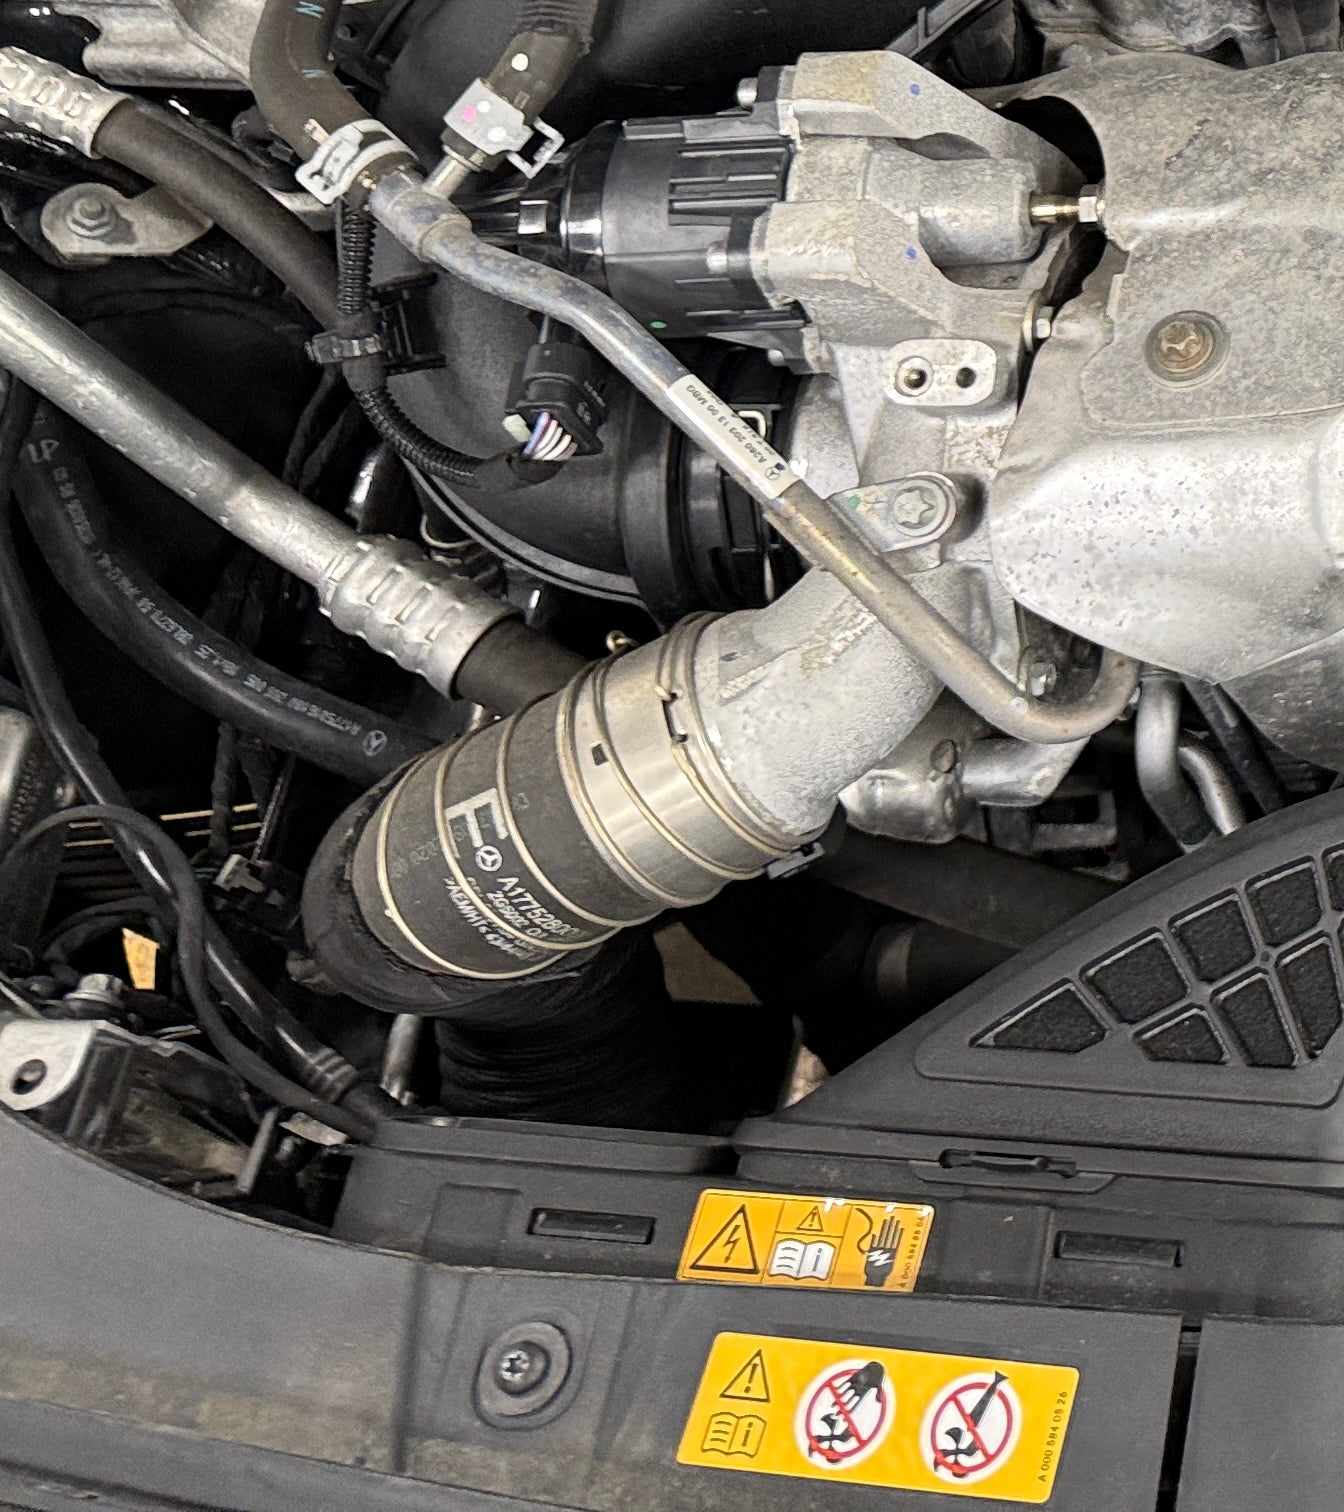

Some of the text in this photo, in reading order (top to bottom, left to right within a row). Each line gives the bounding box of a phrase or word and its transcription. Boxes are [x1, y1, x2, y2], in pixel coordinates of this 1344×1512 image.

[1056, 1391, 1068, 1405] 26
[1040, 1449, 1054, 1472] 000
[1037, 1474, 1047, 1482] A
